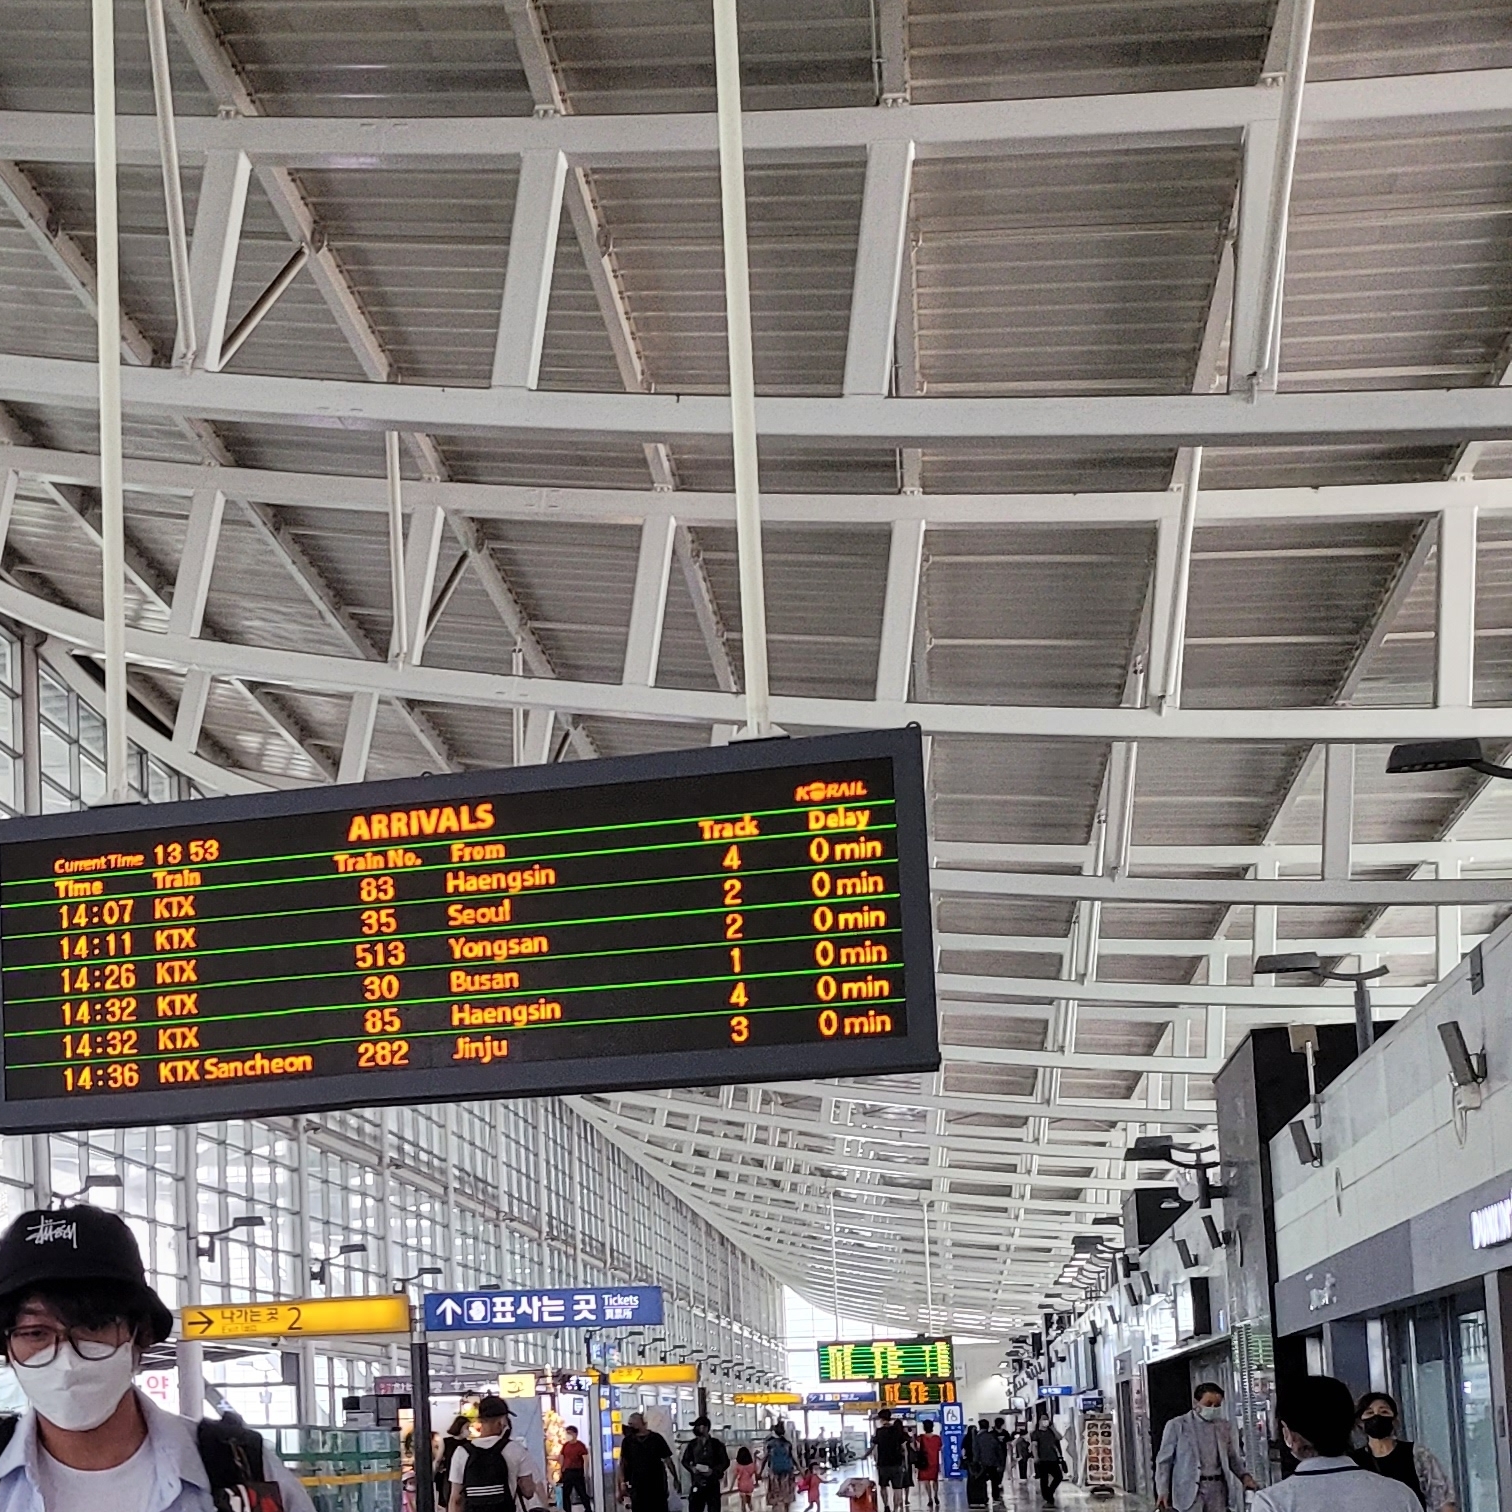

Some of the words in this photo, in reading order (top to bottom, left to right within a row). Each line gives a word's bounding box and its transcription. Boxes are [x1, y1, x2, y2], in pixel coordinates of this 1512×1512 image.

[348, 803, 494, 841] ARRIVALS
[54, 856, 107, 873] Current
[108, 853, 145, 869] Time
[154, 843, 182, 865] 13
[189, 839, 219, 862] 53
[55, 880, 103, 898] Time
[152, 869, 201, 889] Train
[333, 852, 380, 872] Train
[381, 849, 422, 868] No.
[451, 843, 505, 862] From
[698, 816, 759, 839] Track
[808, 808, 870, 830] Delay
[59, 899, 133, 928] 14:07
[154, 895, 195, 919] KTX
[360, 876, 395, 901] 83
[446, 864, 555, 893] Haengsin
[723, 845, 741, 869] 4
[811, 840, 830, 861] 0
[839, 836, 882, 860] min
[60, 932, 131, 960] 14:11
[155, 927, 196, 951] KTX
[361, 909, 397, 934] 35
[448, 899, 511, 925] Seoul
[724, 879, 742, 905] 2
[812, 873, 831, 897] 0
[839, 871, 884, 895] min
[61, 964, 135, 993] 14:26
[156, 960, 197, 984] KTX
[356, 941, 405, 968] 513
[448, 937, 548, 962] Yongsan
[726, 914, 743, 939] 2
[814, 907, 833, 931] 0
[839, 906, 885, 930] min
[62, 997, 136, 1025] 14:32
[157, 993, 198, 1016] KTX
[363, 975, 399, 1000] 30
[450, 971, 519, 992] Busan
[731, 948, 741, 973] 1
[815, 941, 834, 966] 0
[840, 940, 887, 964] min
[63, 1030, 138, 1058] 14:32
[159, 1027, 199, 1050] KTX
[365, 1008, 401, 1033] 85
[452, 998, 561, 1027] Haengsin
[730, 982, 748, 1007] 4
[817, 976, 837, 1001] 0
[842, 975, 889, 999] min
[64, 1063, 139, 1091] 14:36
[159, 1059, 200, 1083] KTX
[204, 1053, 312, 1079] Sancheon
[358, 1040, 409, 1067] 282
[453, 1036, 507, 1063] Jinju
[730, 1016, 748, 1041] 3
[819, 1012, 837, 1035] 0
[844, 1010, 891, 1035] min
[221, 1308, 261, 1322] 나가는
[266, 1307, 278, 1321] 곳
[287, 1306, 303, 1330] 2
[573, 1295, 597, 1320] 곳
[601, 1293, 639, 1305] Tickets
[146, 1376, 169, 1400] 약
[635, 1367, 644, 1381] 2
